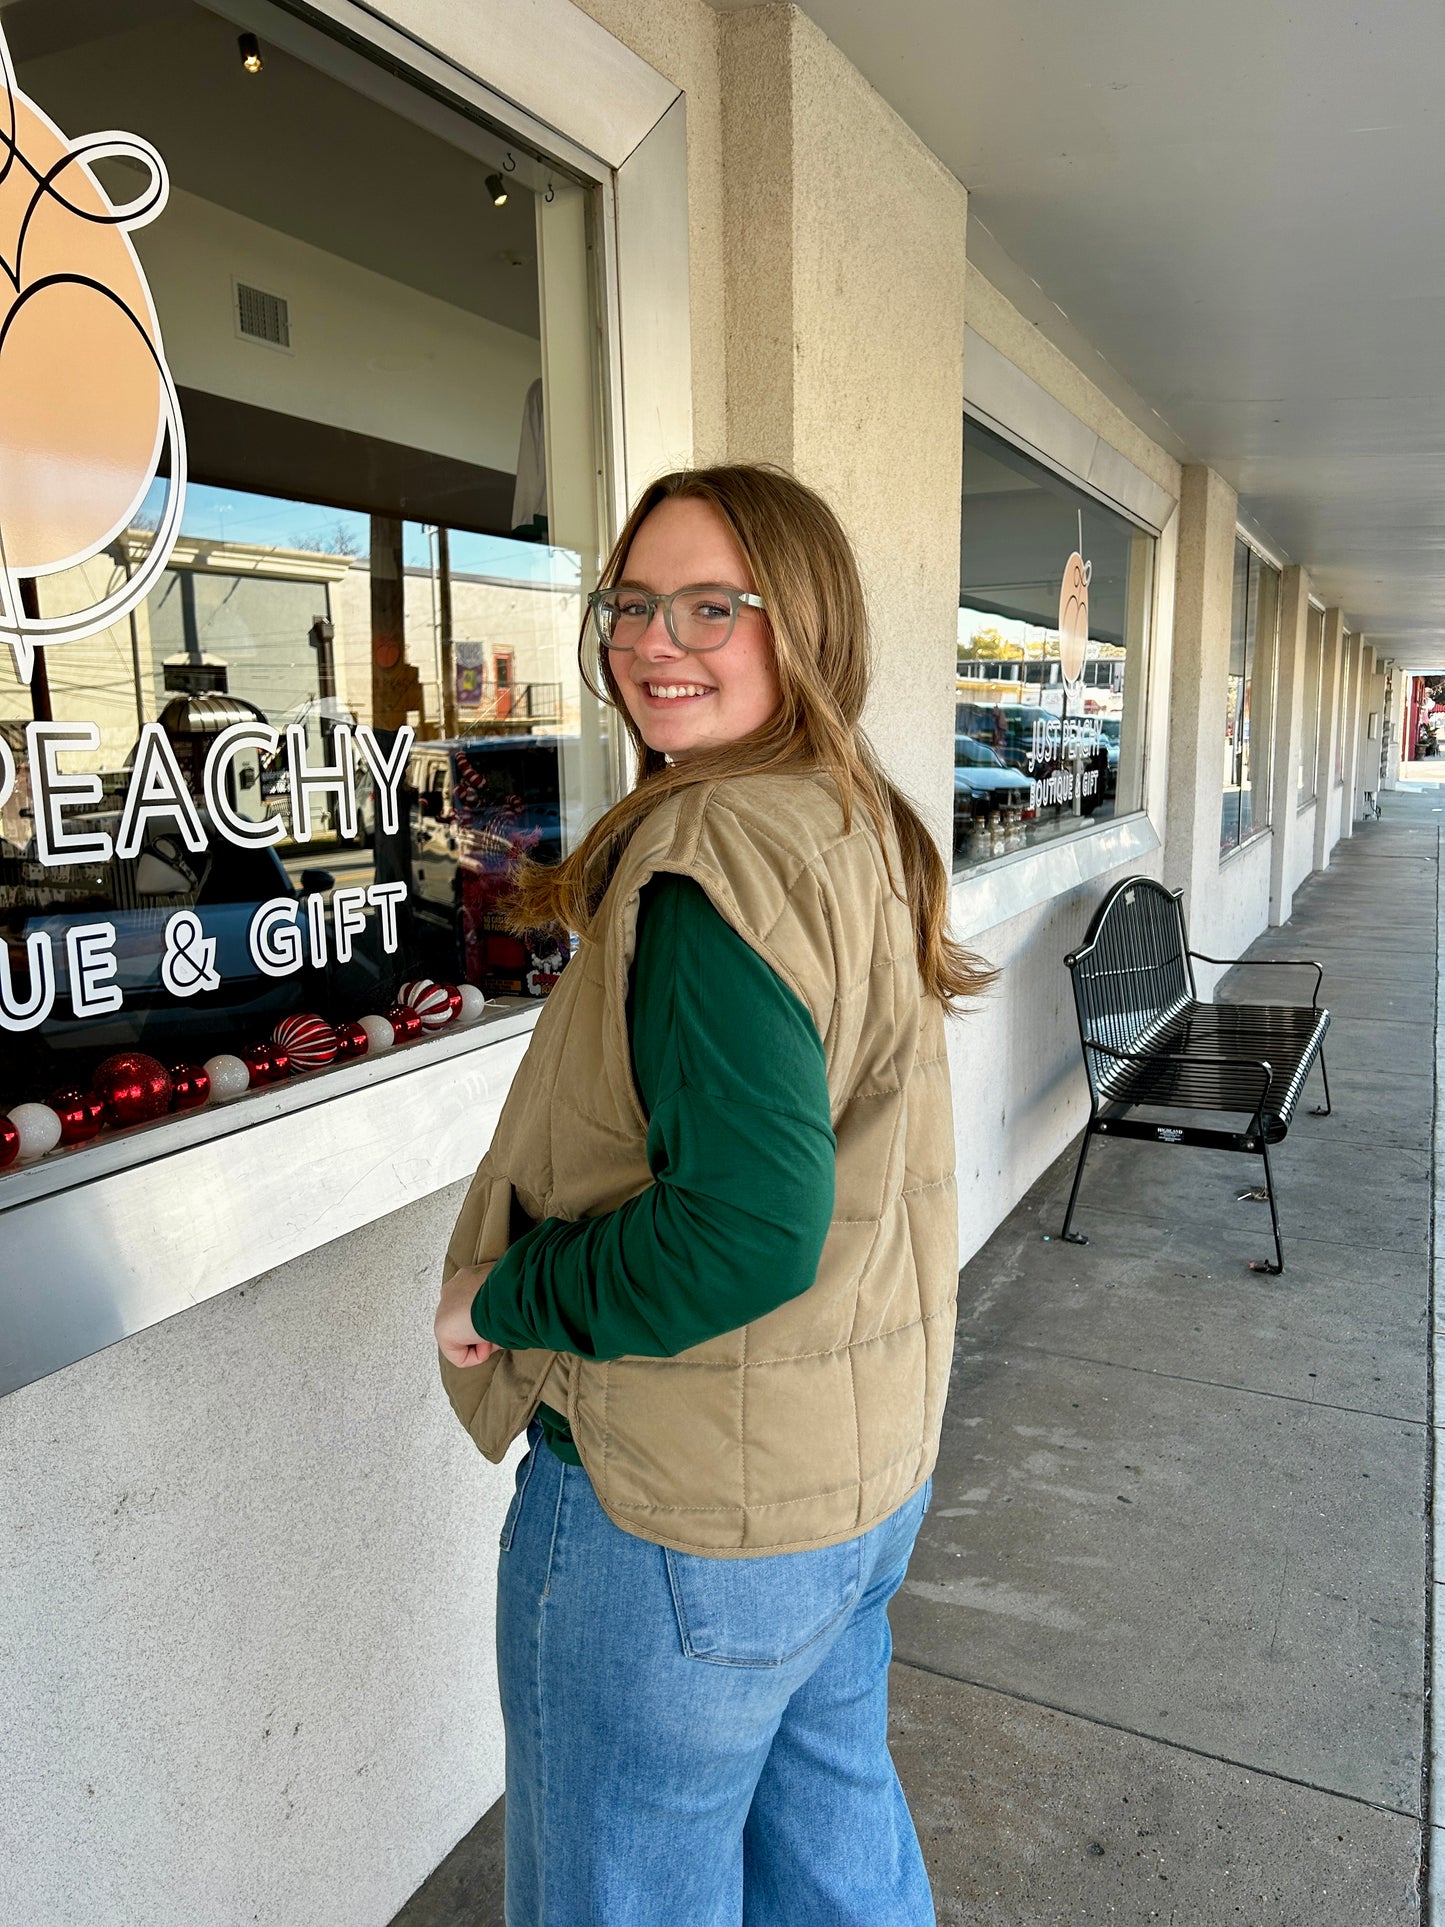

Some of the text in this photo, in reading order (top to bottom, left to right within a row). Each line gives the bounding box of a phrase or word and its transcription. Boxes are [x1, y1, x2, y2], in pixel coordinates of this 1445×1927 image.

[1026, 719, 1103, 772] JUST PEACHY
[1029, 770, 1099, 810] BOUTIQUE & GIFT
[161, 910, 222, 998] &
[249, 881, 408, 978] GIFT
